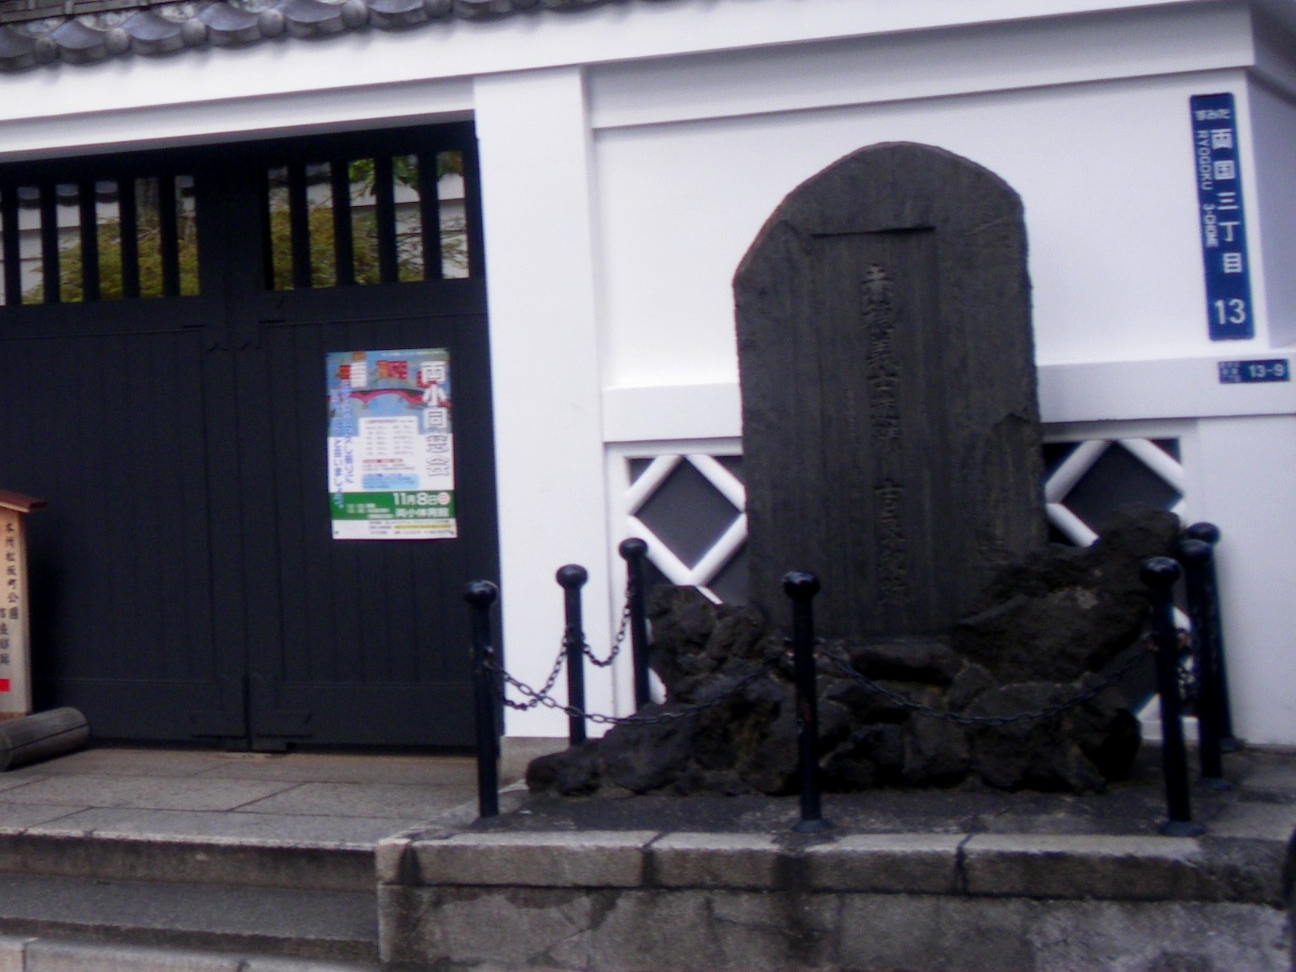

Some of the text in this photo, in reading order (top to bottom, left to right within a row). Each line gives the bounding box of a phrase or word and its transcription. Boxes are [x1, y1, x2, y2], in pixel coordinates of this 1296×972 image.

[1195, 130, 1213, 191] RYOGOKU
[1210, 127, 1243, 274] 両国三丁目
[1214, 297, 1246, 326] 13
